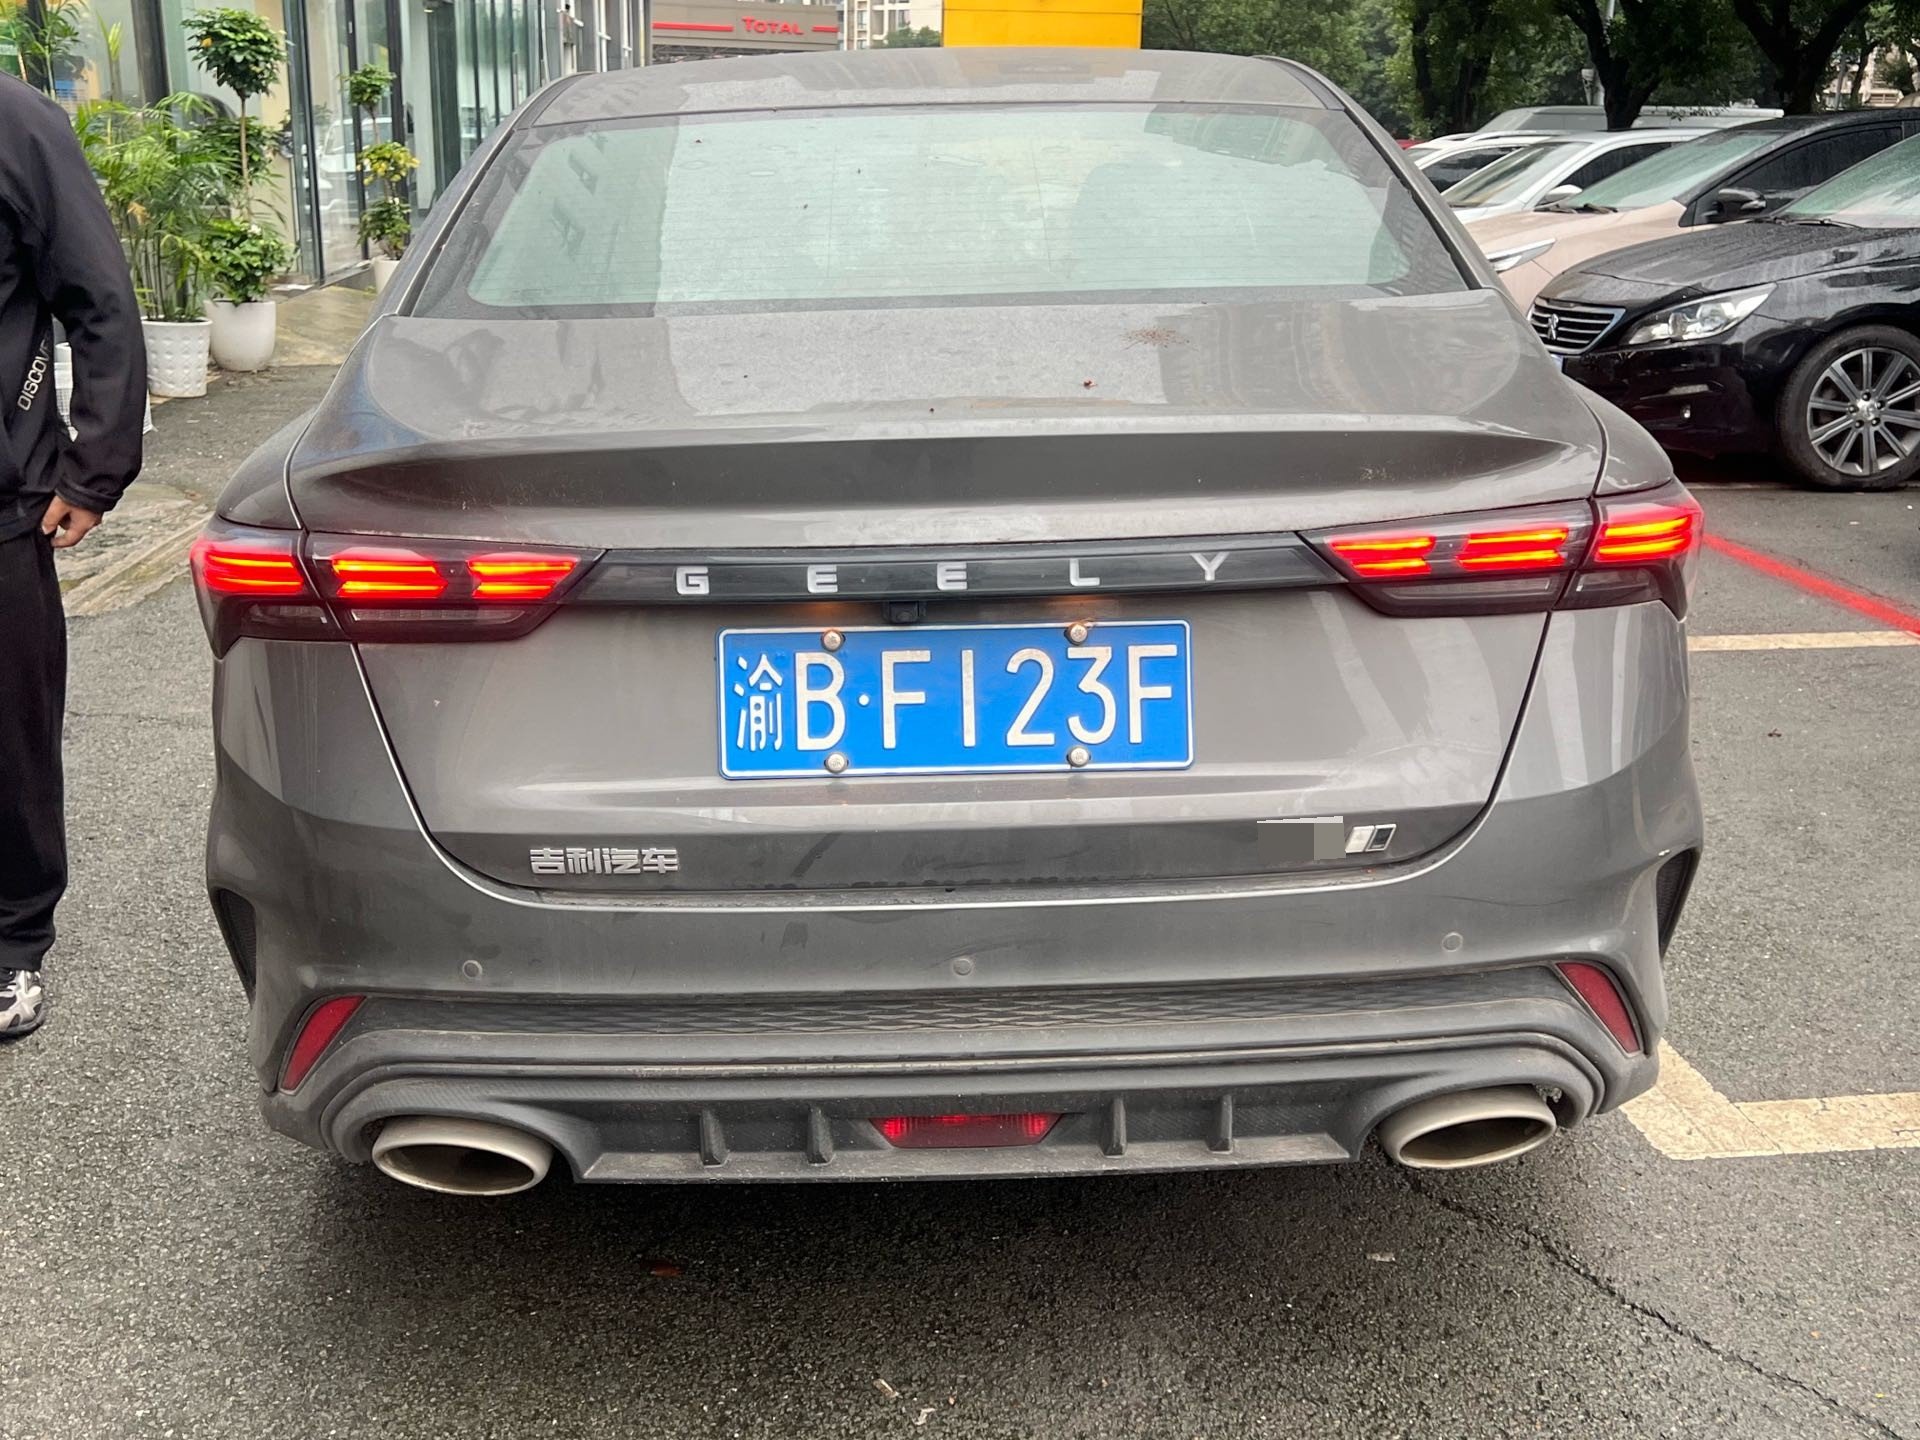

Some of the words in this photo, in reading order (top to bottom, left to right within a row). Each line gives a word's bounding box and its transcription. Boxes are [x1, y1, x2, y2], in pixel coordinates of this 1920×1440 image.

[741, 15, 805, 36] TOTAL
[675, 551, 1231, 595] GEELY
[529, 847, 680, 874] 吉利汽车
